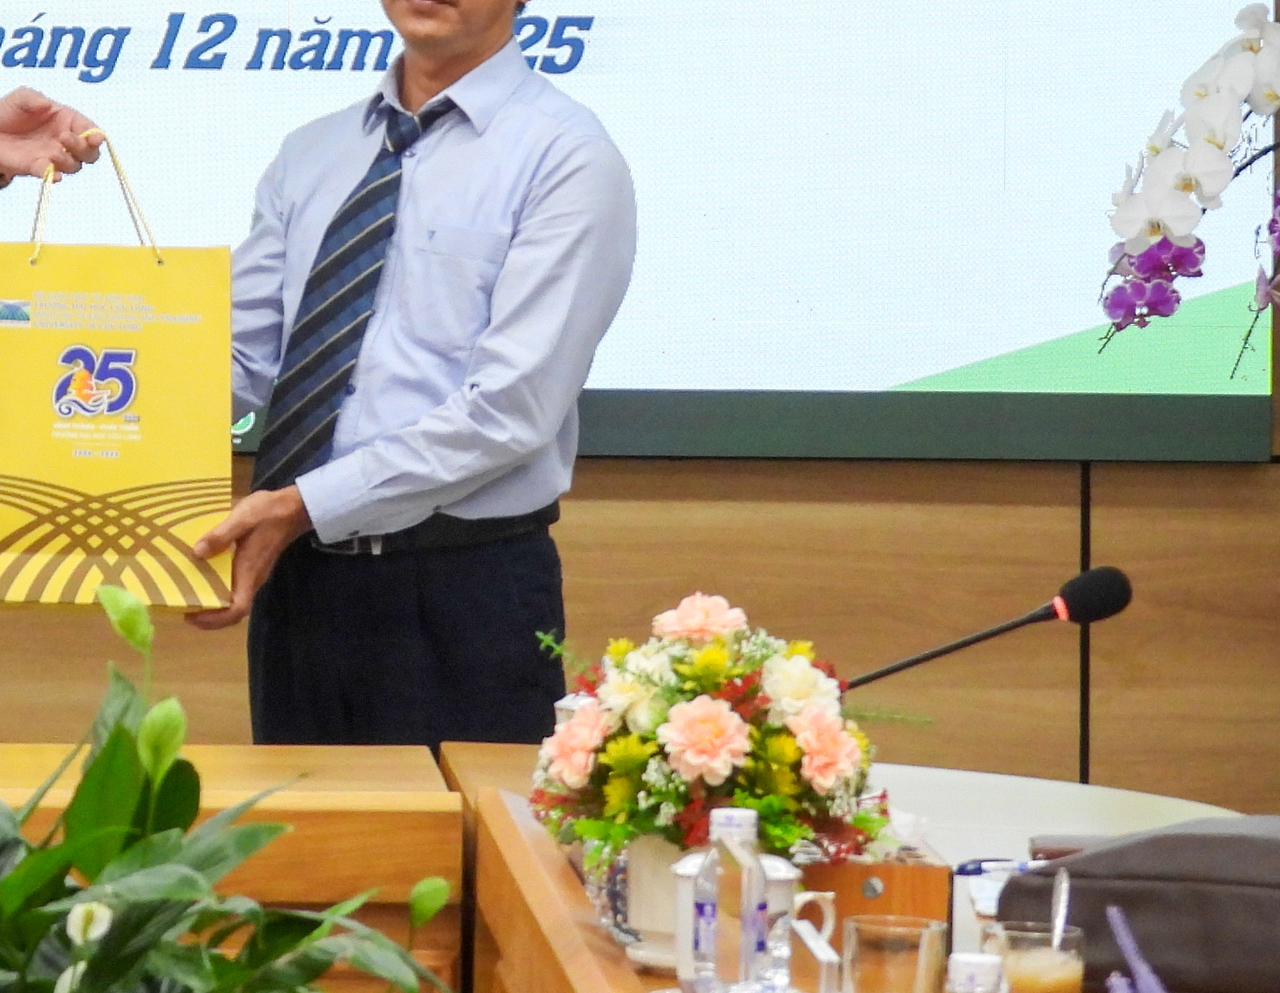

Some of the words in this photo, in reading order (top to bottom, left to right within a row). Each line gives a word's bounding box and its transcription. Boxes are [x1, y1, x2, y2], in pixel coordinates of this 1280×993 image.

[151, 12, 238, 71] 12
[246, 15, 394, 72] năm
[513, 16, 595, 75] 25
[53, 344, 136, 417] 25
